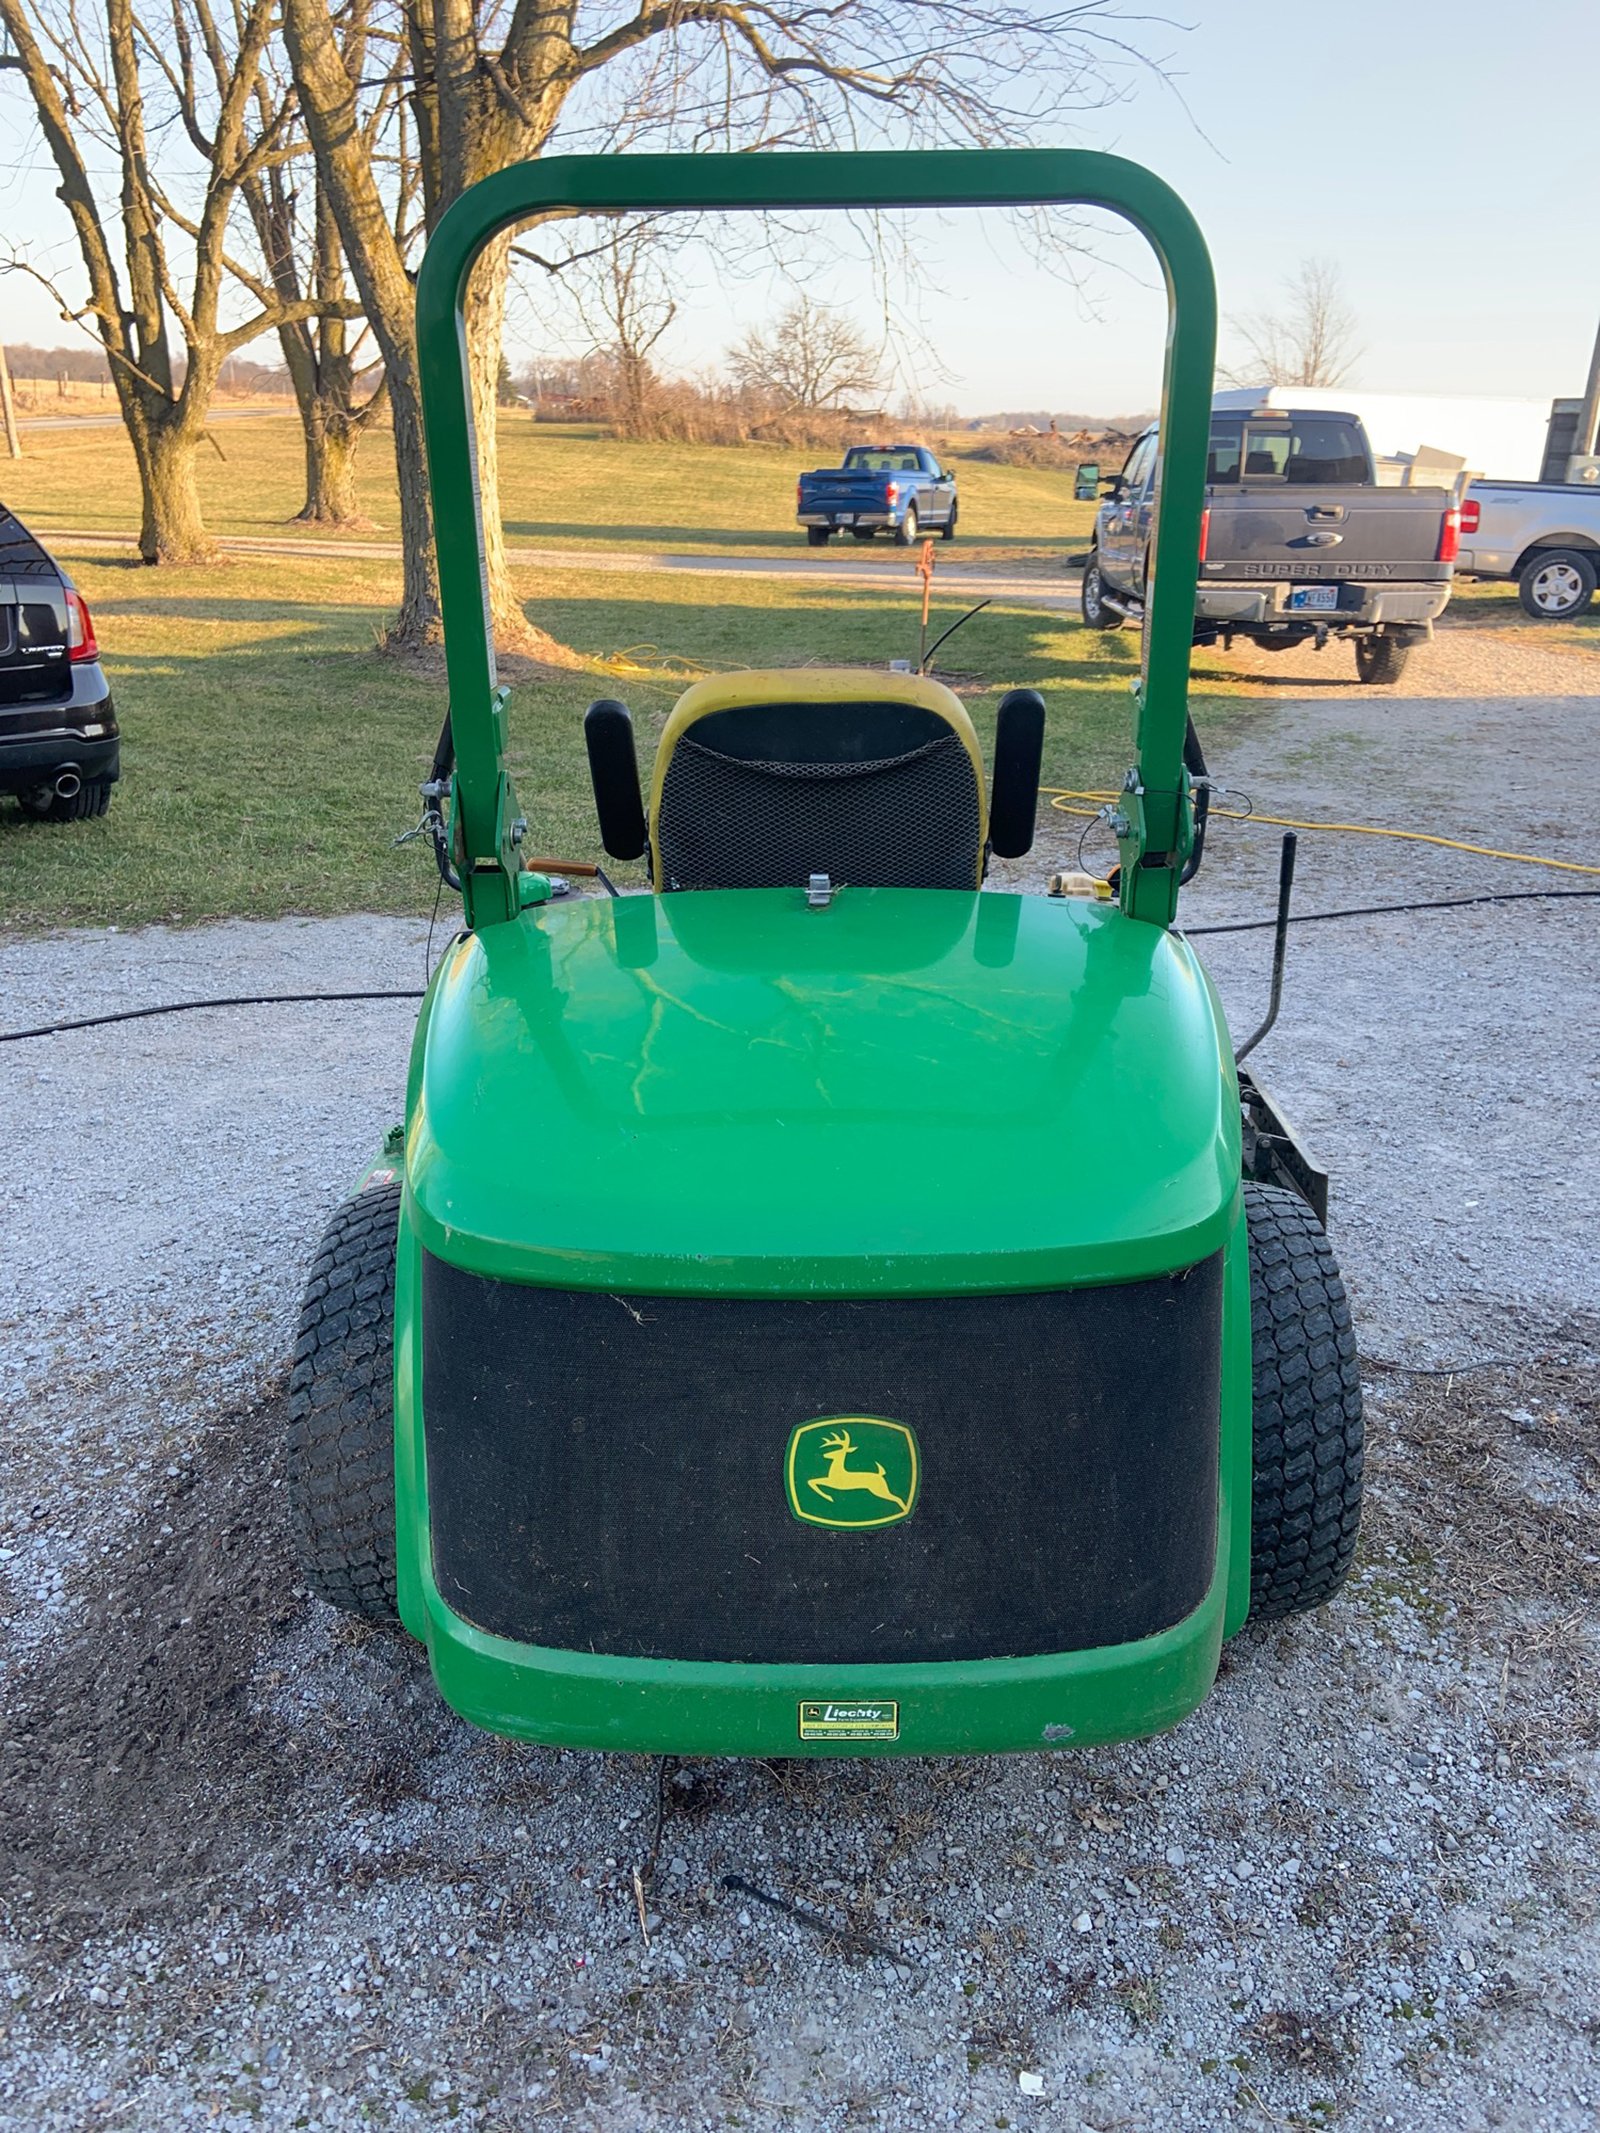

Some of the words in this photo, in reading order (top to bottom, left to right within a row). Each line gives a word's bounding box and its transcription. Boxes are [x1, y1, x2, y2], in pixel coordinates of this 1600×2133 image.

[1244, 563, 1321, 576] SUPER
[1335, 563, 1398, 576] DUTY
[824, 1705, 882, 1721] Liechty
